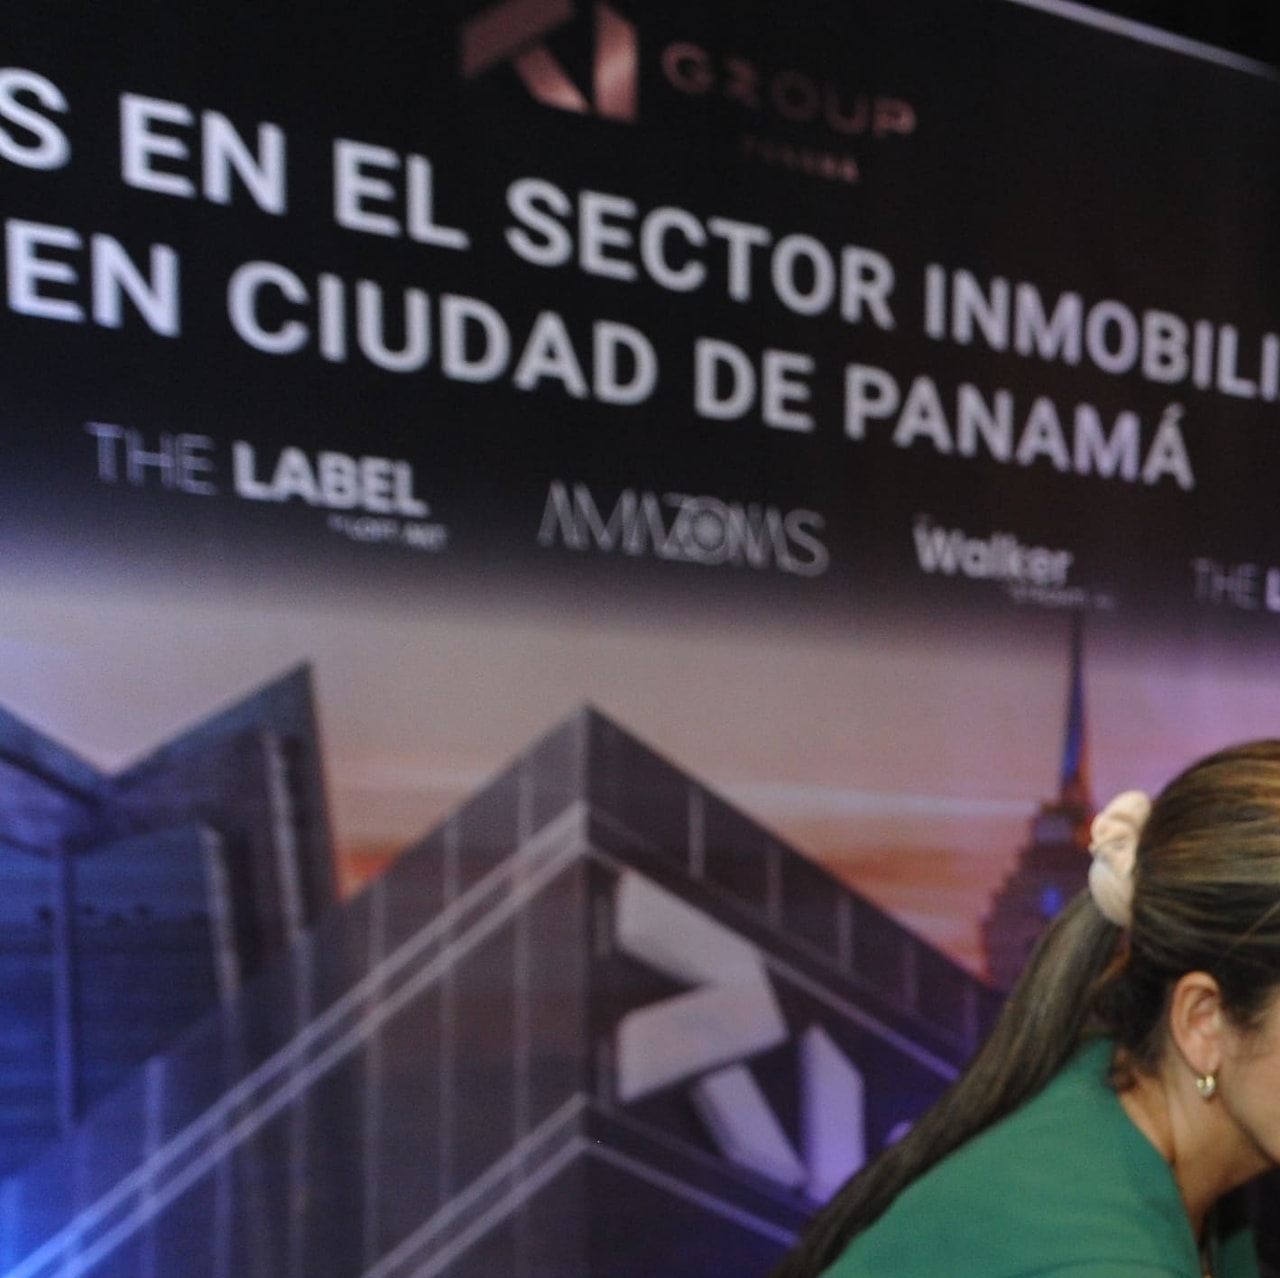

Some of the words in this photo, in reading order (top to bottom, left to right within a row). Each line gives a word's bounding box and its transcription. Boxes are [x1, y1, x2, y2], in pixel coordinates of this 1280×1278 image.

[118, 91, 289, 217] EN
[332, 138, 470, 250] EL
[504, 177, 896, 331] SECTOR
[4, 217, 182, 340] EN
[226, 261, 660, 405] CIUDAD
[693, 337, 816, 432] DE
[844, 363, 1195, 491] PANAMÁ
[86, 421, 216, 496] THE
[231, 439, 430, 519] LABEL
[912, 515, 1074, 587] Walker
